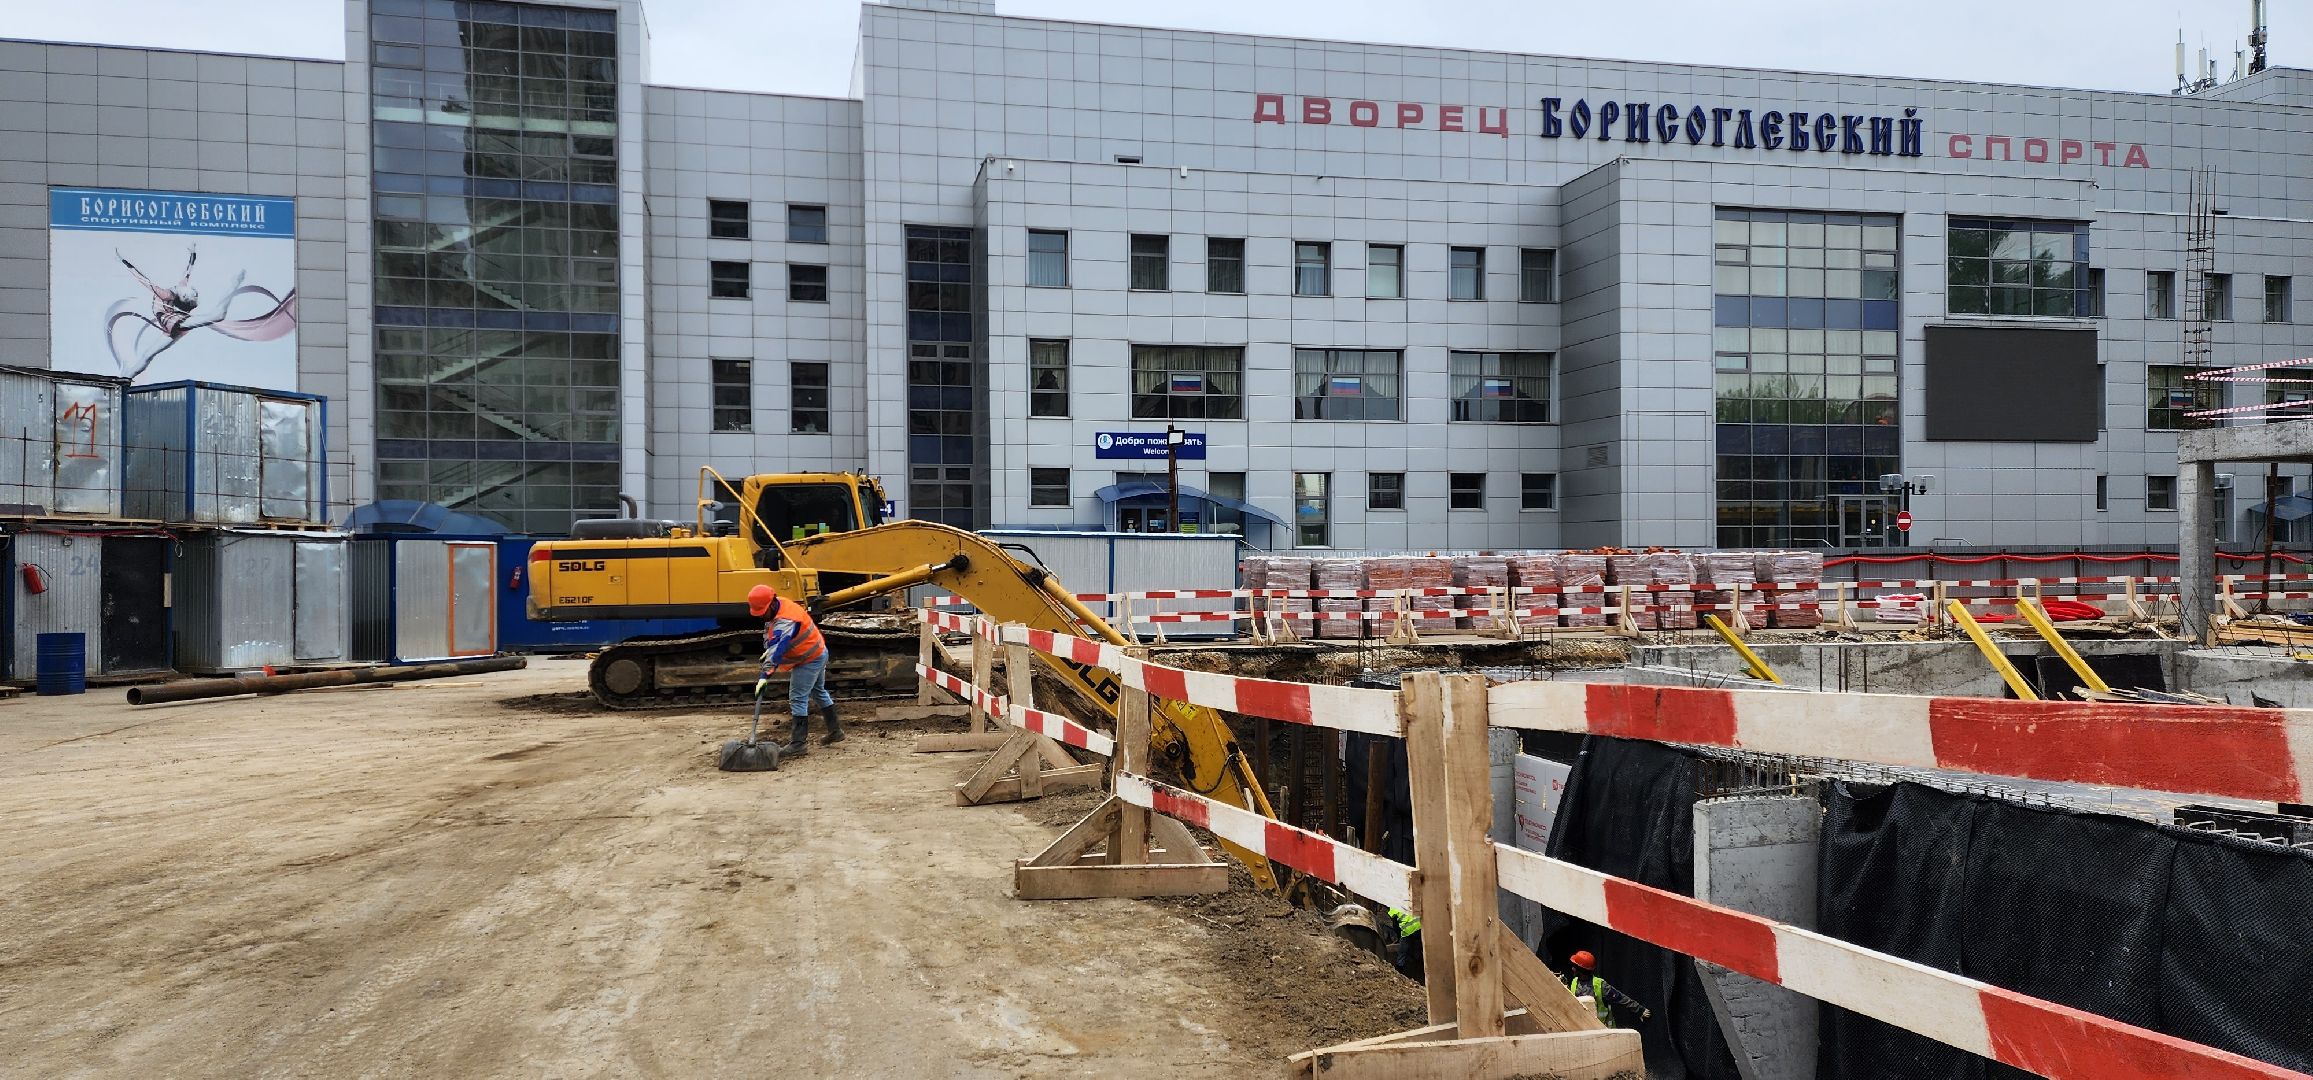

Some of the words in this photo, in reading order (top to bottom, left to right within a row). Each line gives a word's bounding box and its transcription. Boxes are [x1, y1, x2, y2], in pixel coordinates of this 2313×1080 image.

[1253, 94, 1508, 138] ДВОРЕЦ
[1541, 97, 1924, 157] БОРИСОГЛЕБСКИЙ
[1949, 134, 2150, 169] СПОРТА
[80, 197, 265, 223] БОРИСОГЛЕБСКИЙ
[1115, 436, 1145, 447] Добро
[1147, 438, 1203, 446] пожавать
[70, 554, 99, 576] 24
[558, 560, 605, 572] SDLG
